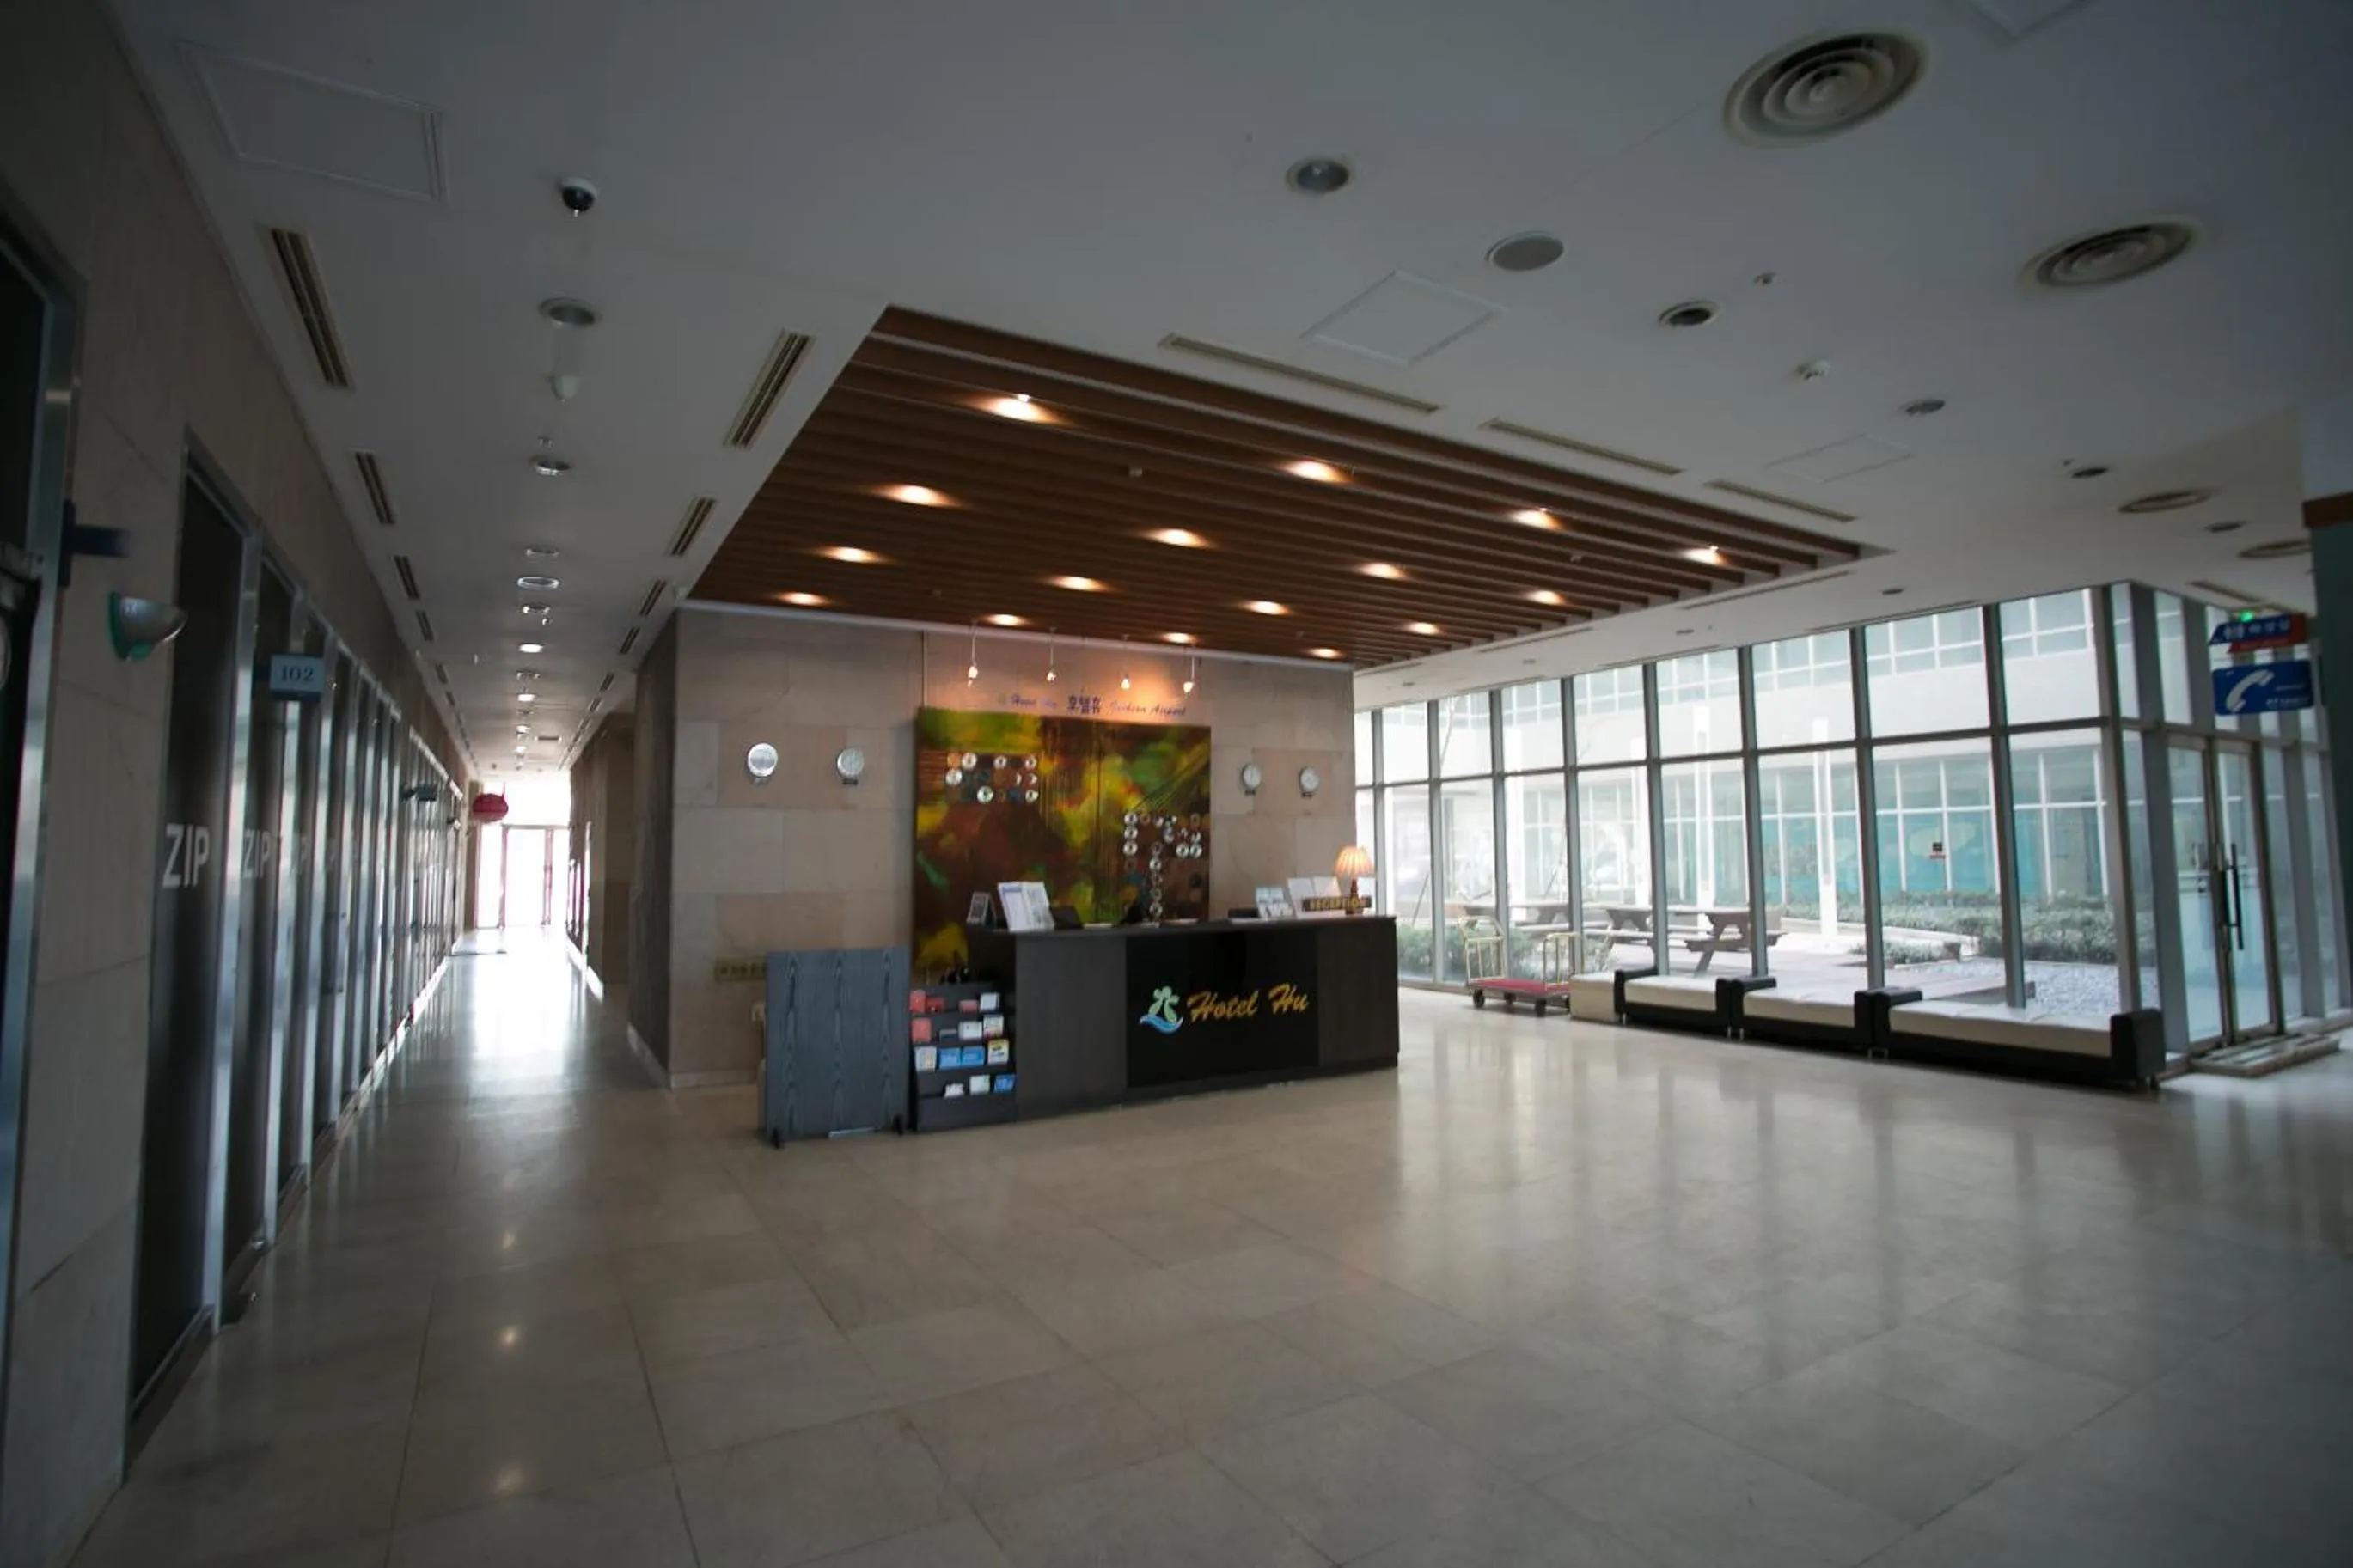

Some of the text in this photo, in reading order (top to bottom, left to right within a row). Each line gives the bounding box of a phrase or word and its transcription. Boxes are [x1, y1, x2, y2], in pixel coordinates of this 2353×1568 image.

[280, 665, 315, 682] 102
[162, 822, 210, 888] ZIP
[241, 827, 272, 879] ZIP
[1309, 894, 1366, 912] RECEPTIO
[1186, 982, 1310, 1023] Hotel Hu
